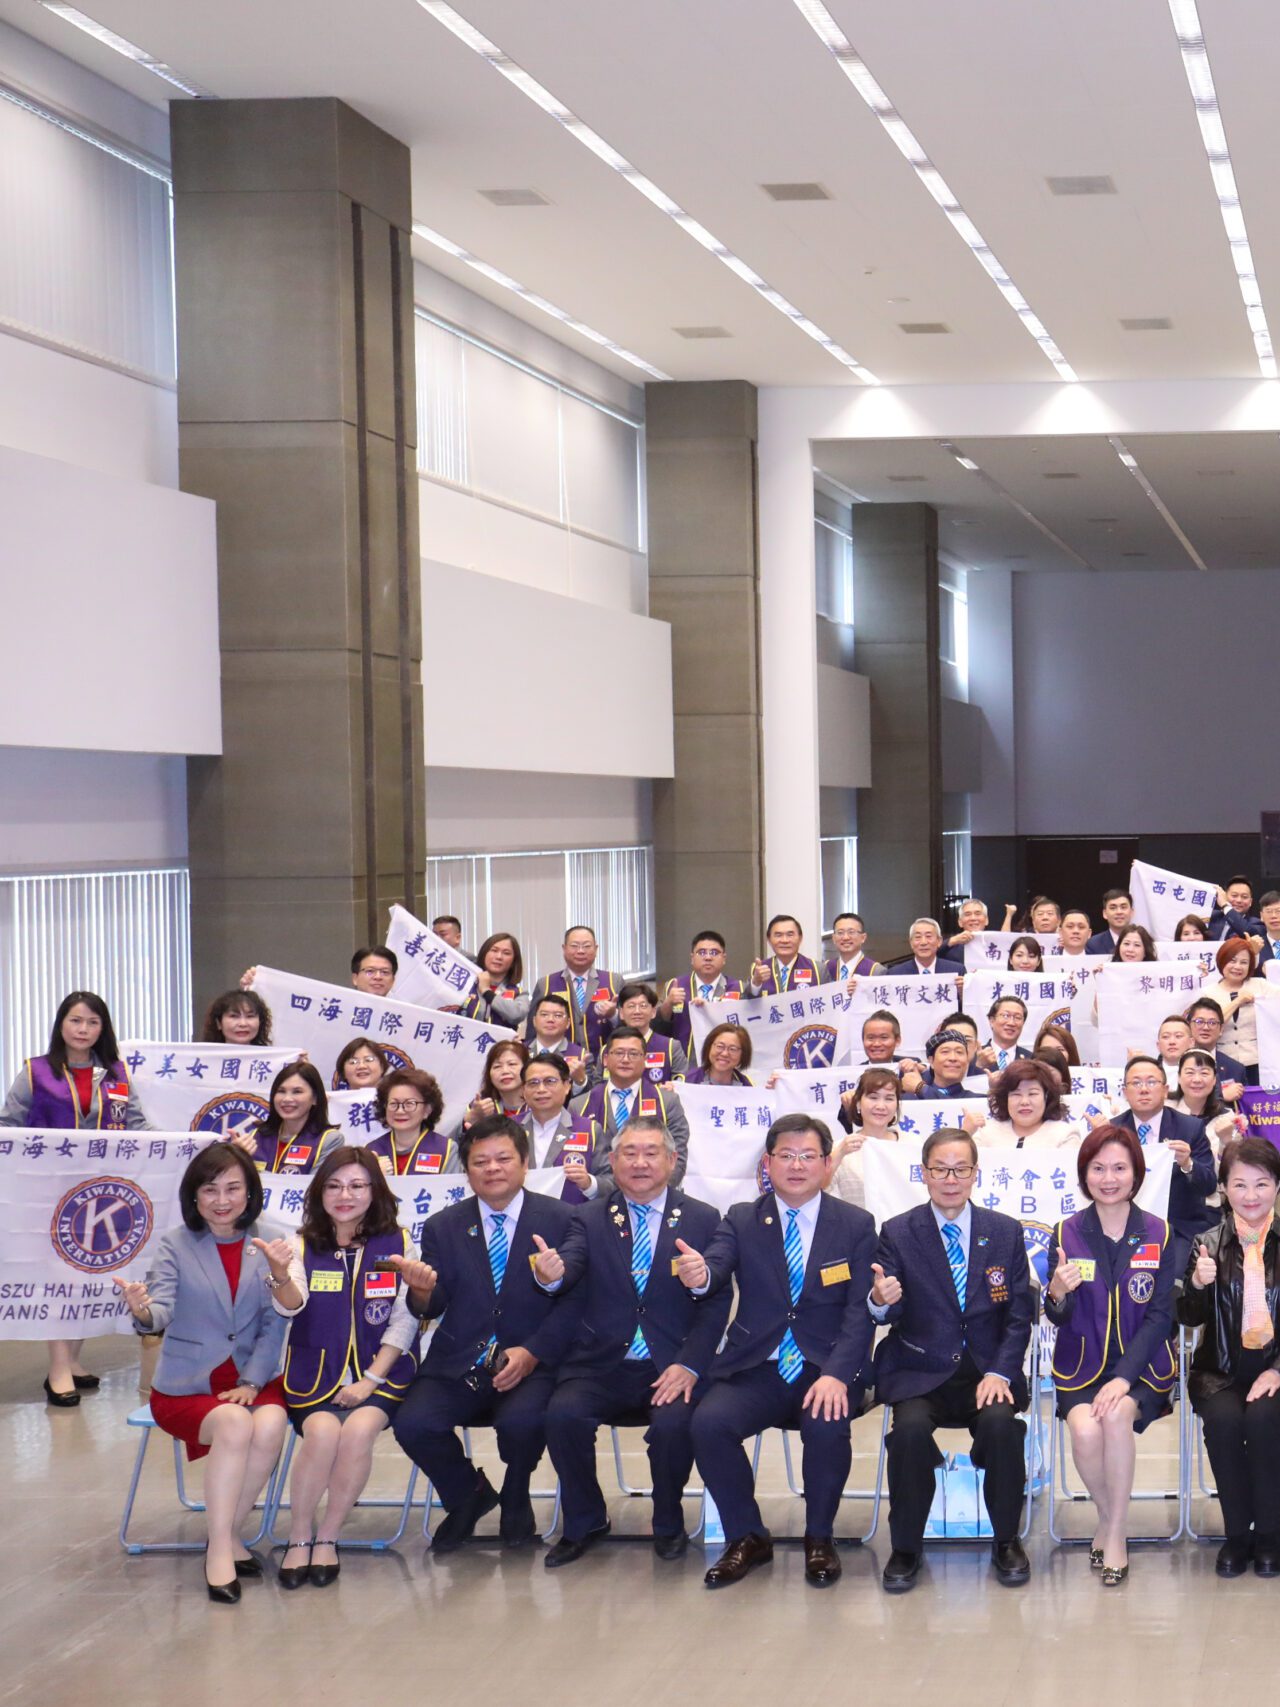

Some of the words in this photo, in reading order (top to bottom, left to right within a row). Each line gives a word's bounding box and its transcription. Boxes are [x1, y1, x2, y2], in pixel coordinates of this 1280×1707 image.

[1152, 880, 1217, 907] 西屯國
[404, 931, 471, 992] 善德國
[872, 983, 952, 1006] 優質文教
[290, 992, 497, 1055] 四海國際同濟會
[793, 1029, 836, 1049] KIWANIS
[208, 1099, 270, 1123] KIWANIS
[710, 1105, 772, 1129] 聖羅蘭
[0, 1135, 228, 1161] 四海女國際同濟
[73, 1183, 140, 1208] KIWANIS
[60, 1215, 145, 1266] INTERNATIONAL
[0, 1282, 35, 1299] SZU
[43, 1282, 74, 1299] HAI
[81, 1282, 104, 1298] NU
